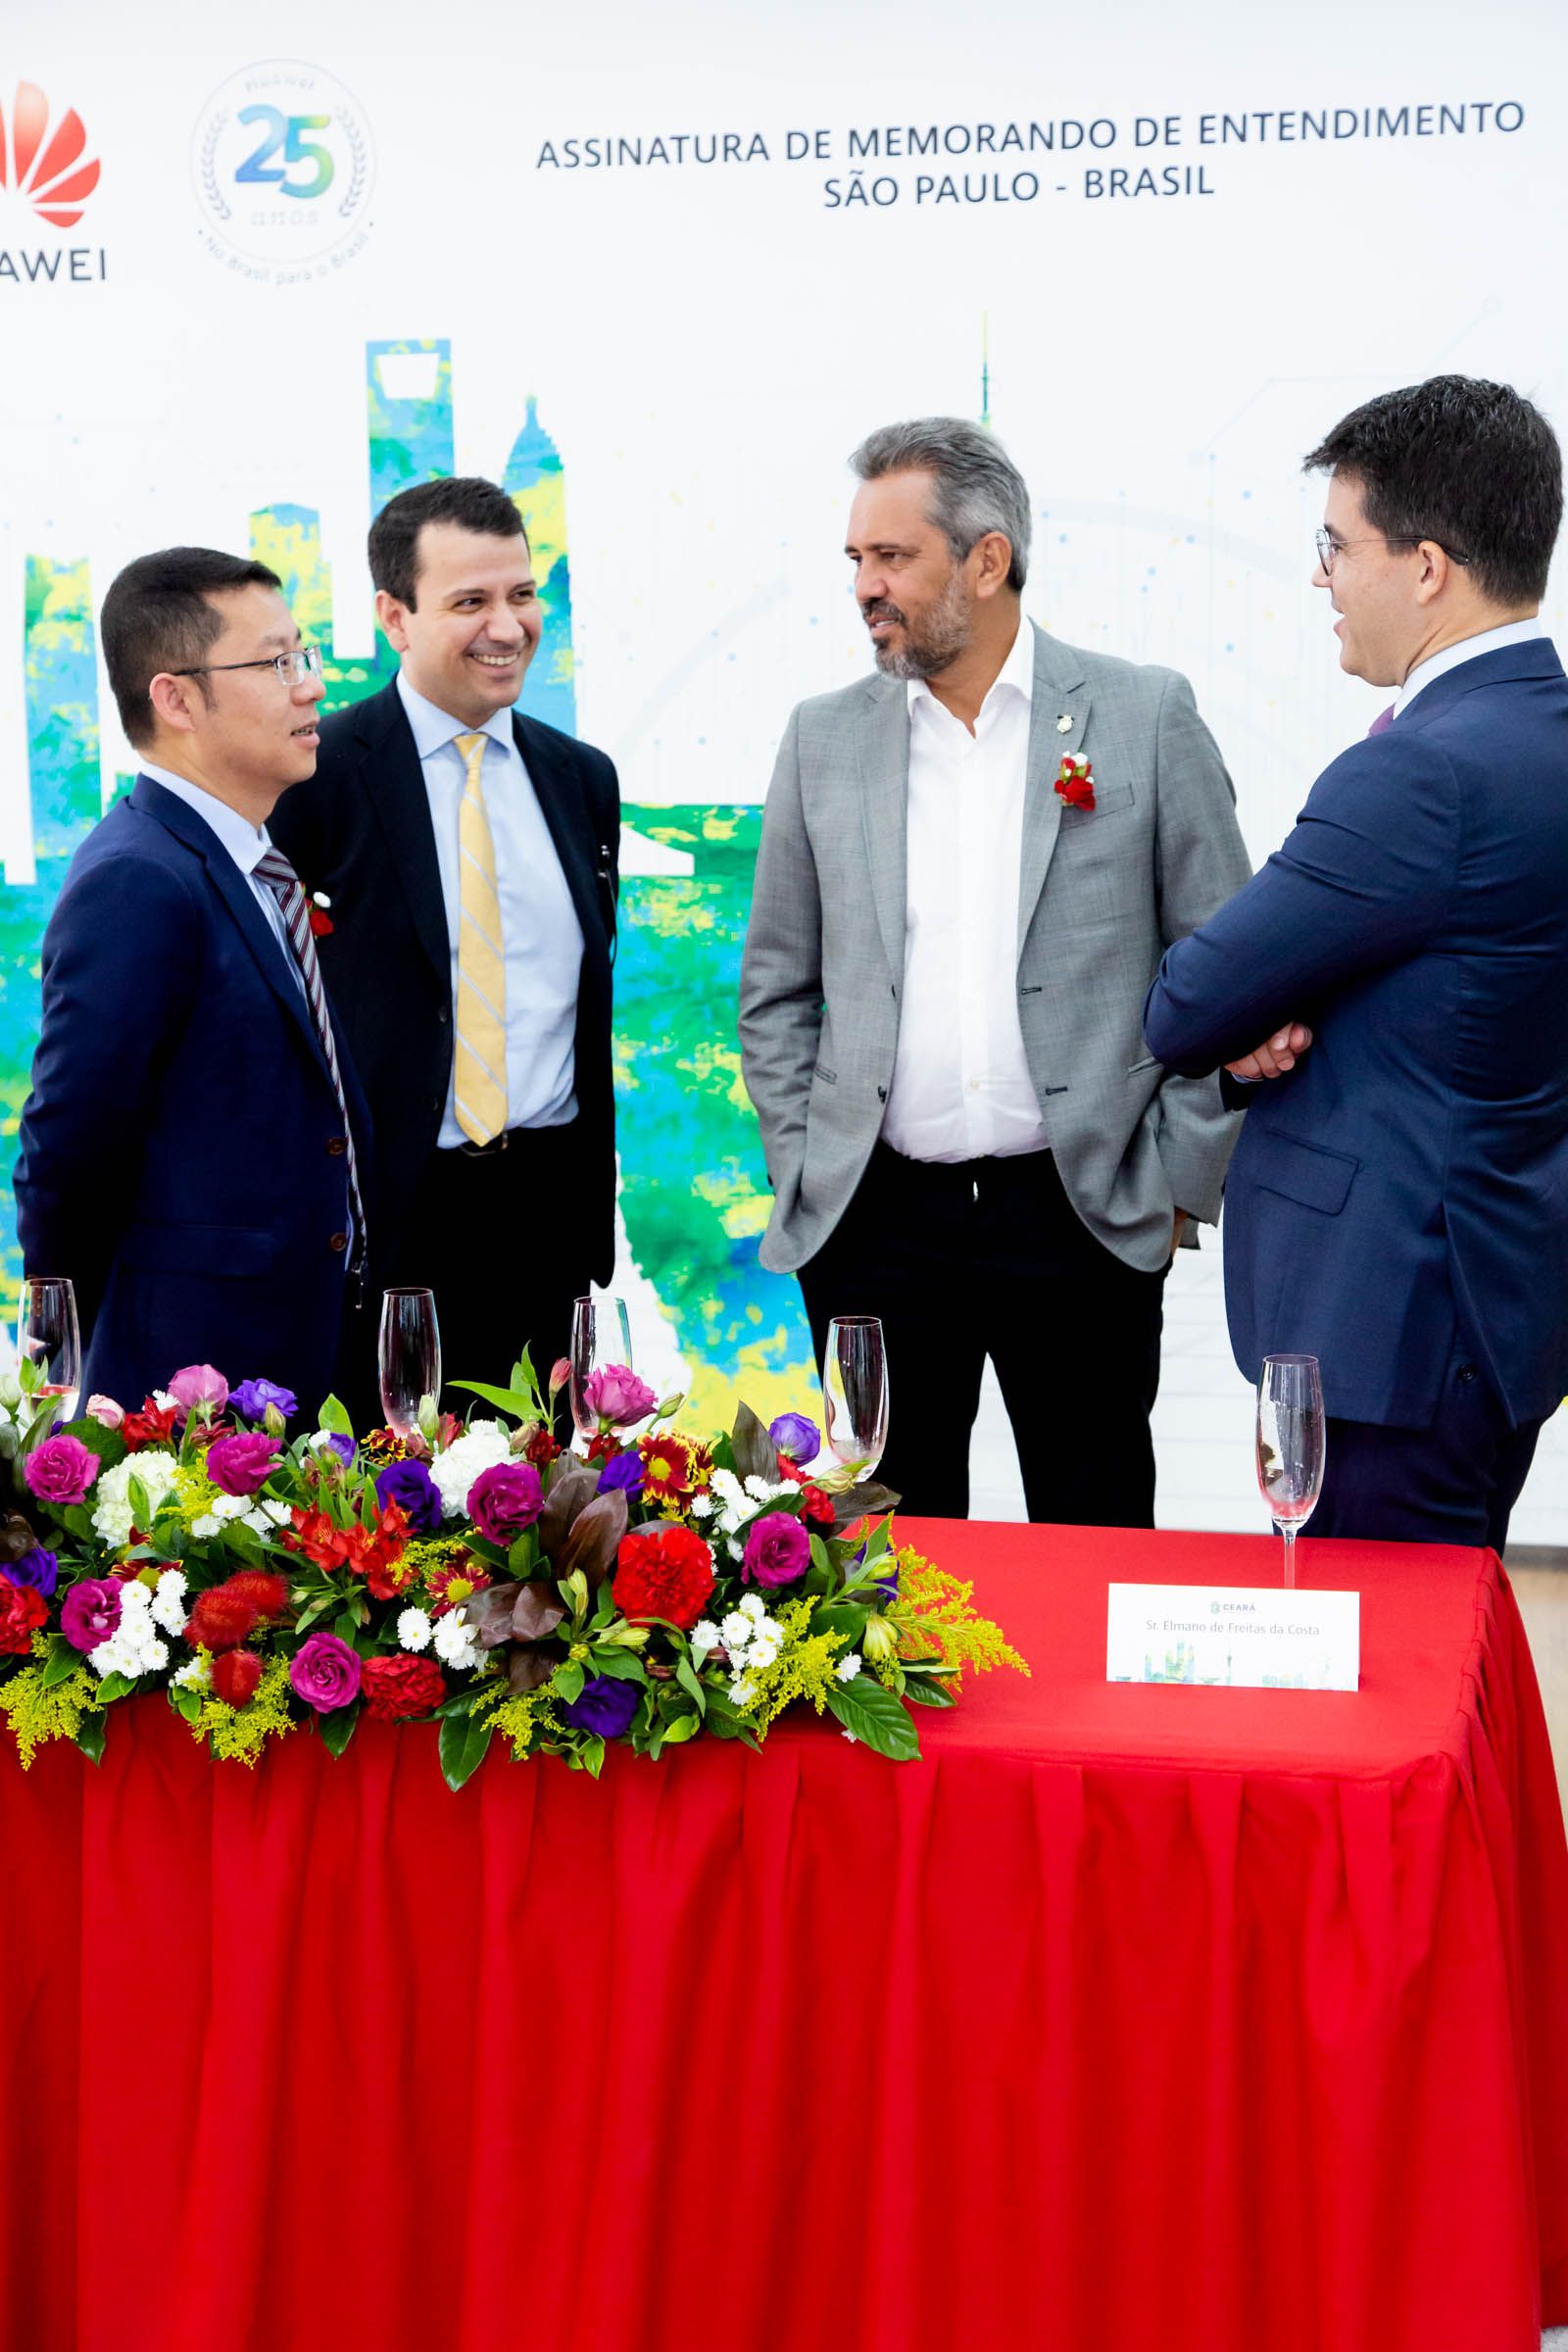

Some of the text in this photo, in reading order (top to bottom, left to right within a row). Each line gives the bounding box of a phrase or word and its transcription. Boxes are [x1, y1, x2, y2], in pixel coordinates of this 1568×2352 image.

[234, 103, 335, 199] 25
[536, 101, 1525, 170] ASSINATURA DE MEMORANDO DE ENTENDIMENTO
[823, 170, 900, 209] SÃO
[916, 171, 1040, 205] PAULO
[1084, 165, 1215, 199] BRASIL
[1146, 1619, 1320, 1637] Sr. Elmano de Freitas da Costa
[1222, 1601, 1256, 1612] CEARÁ
